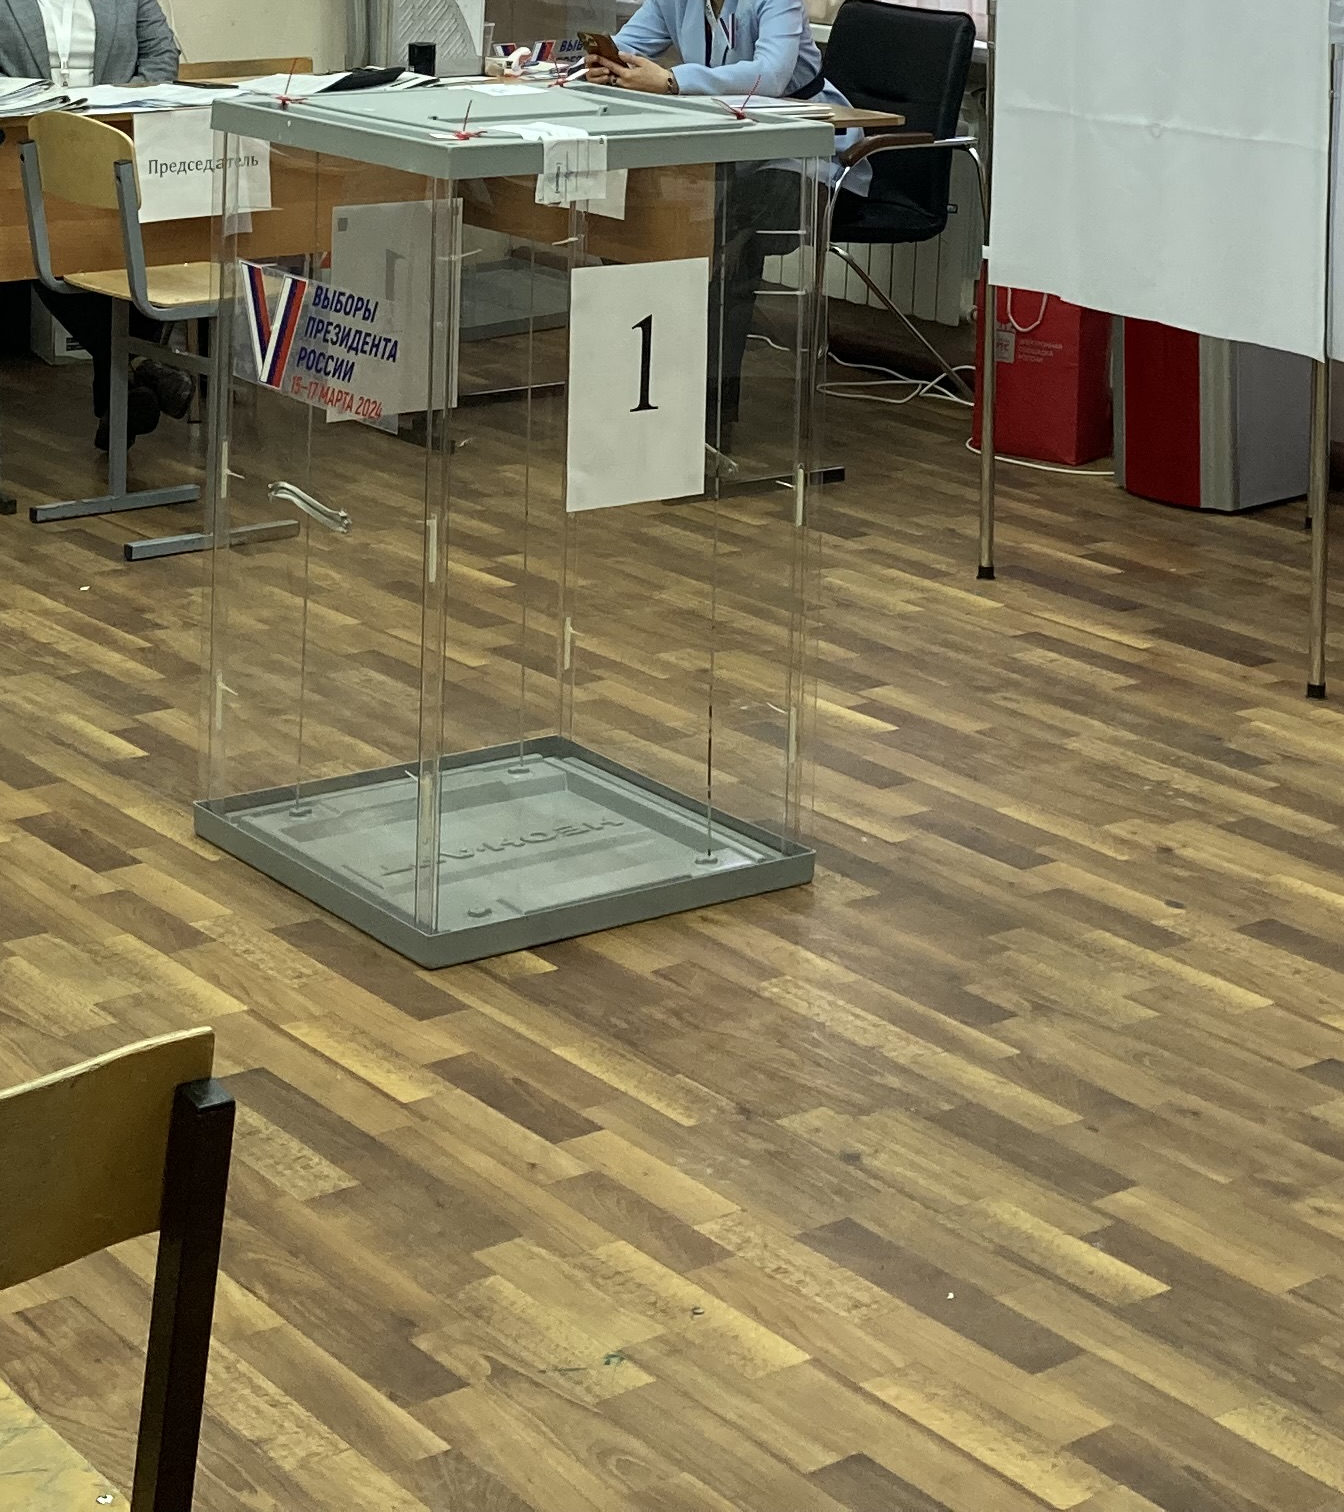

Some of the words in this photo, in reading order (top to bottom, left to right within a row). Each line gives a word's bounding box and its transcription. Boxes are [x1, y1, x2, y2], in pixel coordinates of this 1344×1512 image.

[148, 155, 259, 178] Председатель
[312, 285, 379, 324] ВЫБОРЫ
[304, 315, 399, 364] ПРЕЗИДЕНТА
[296, 345, 356, 384] РОССИИ
[628, 313, 661, 414] 1
[318, 384, 355, 415] МАРТА
[354, 396, 384, 420] 2024
